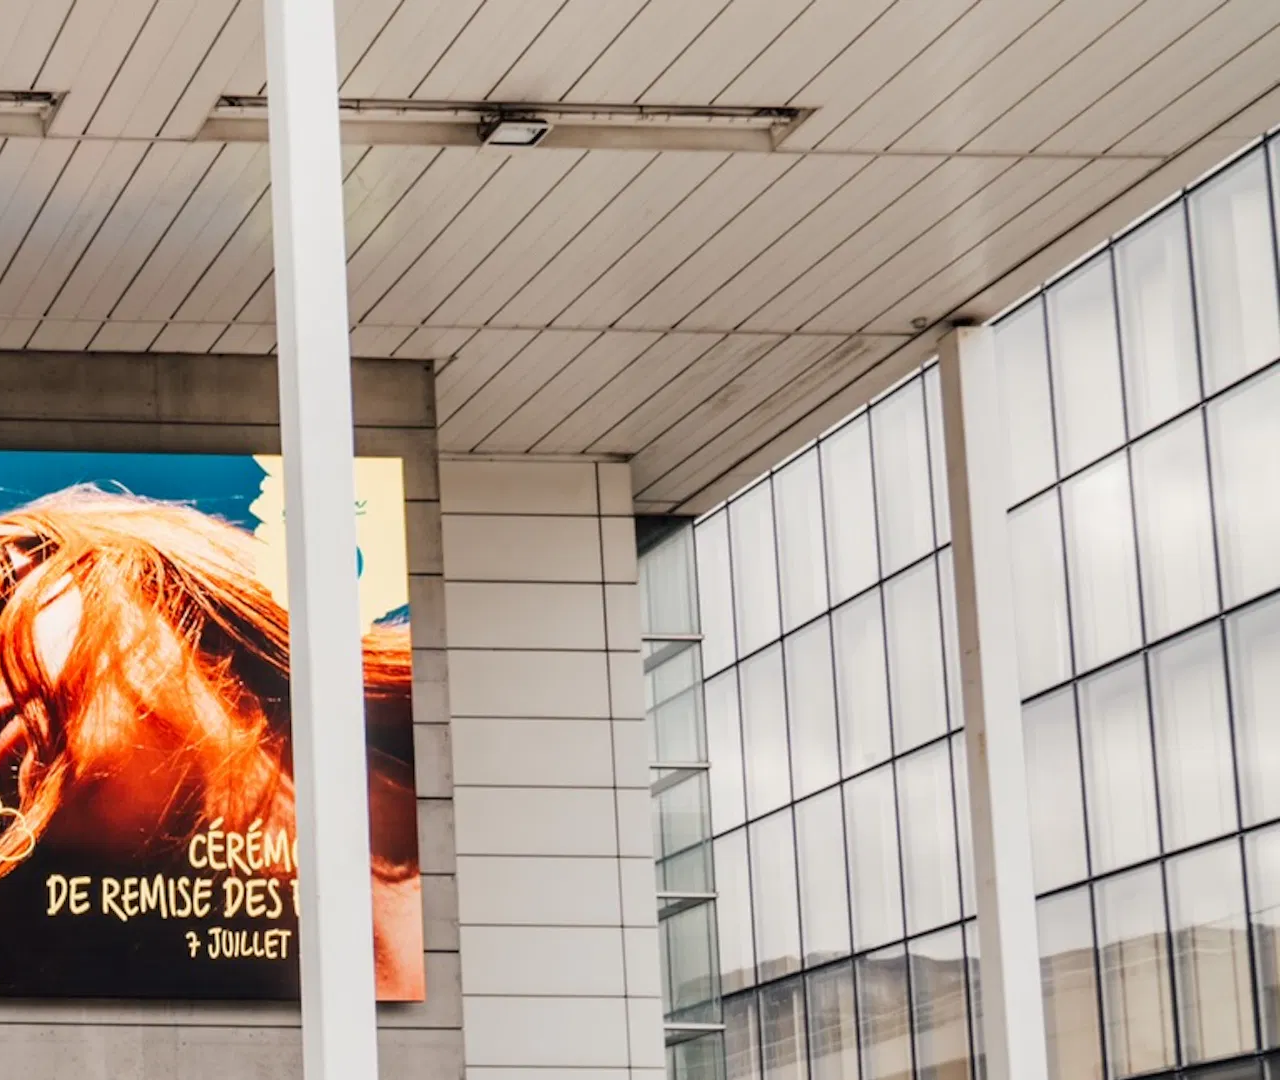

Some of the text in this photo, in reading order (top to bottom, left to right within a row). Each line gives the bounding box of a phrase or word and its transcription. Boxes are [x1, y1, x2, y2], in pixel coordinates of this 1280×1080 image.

[46, 873, 92, 917] DE
[101, 873, 213, 922] REMISE
[222, 876, 284, 919] DES
[185, 926, 292, 959] 7 JUILLET
